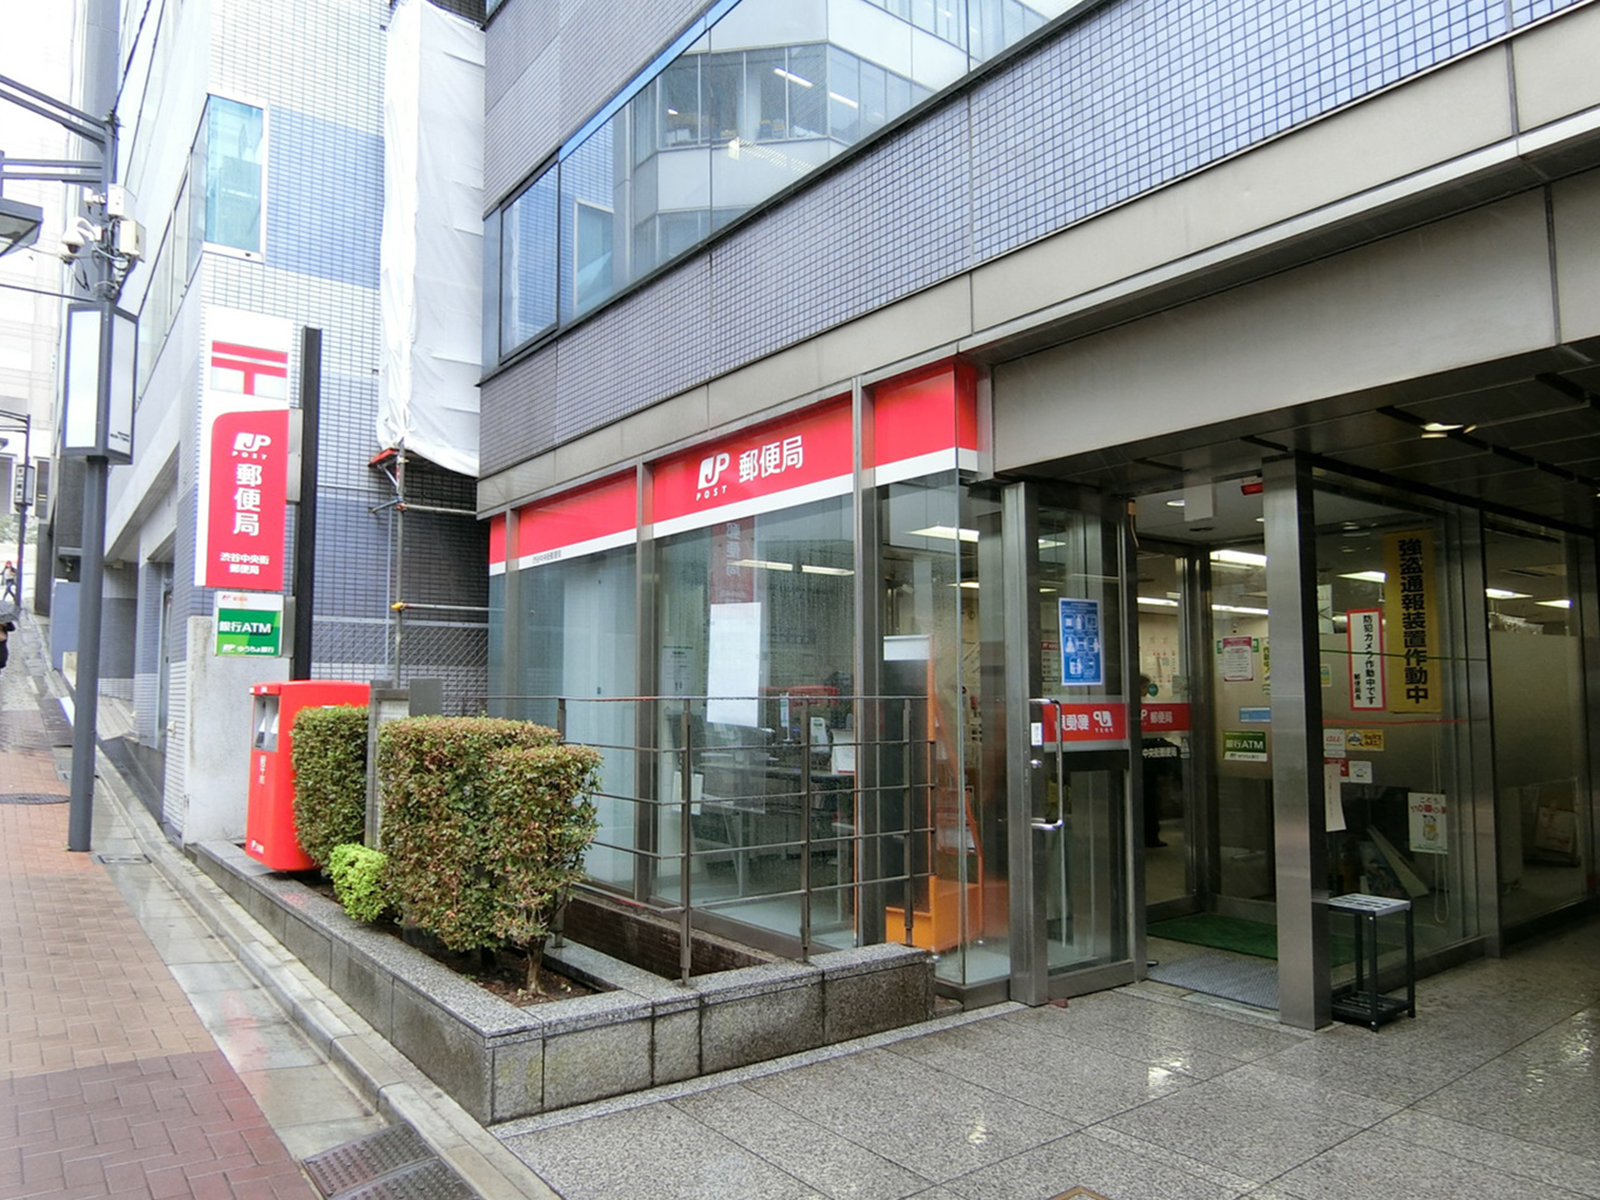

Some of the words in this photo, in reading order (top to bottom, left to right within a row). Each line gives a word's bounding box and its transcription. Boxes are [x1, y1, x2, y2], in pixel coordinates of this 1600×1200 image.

[738, 434, 803, 483] 郵便局
[233, 463, 263, 536] 郵便局
[696, 485, 727, 501] POST
[219, 620, 272, 634] 銀行ATM
[1398, 539, 1429, 704] 強盗通報装置作動中
[1363, 614, 1378, 705] 防犯カメラ作動中です
